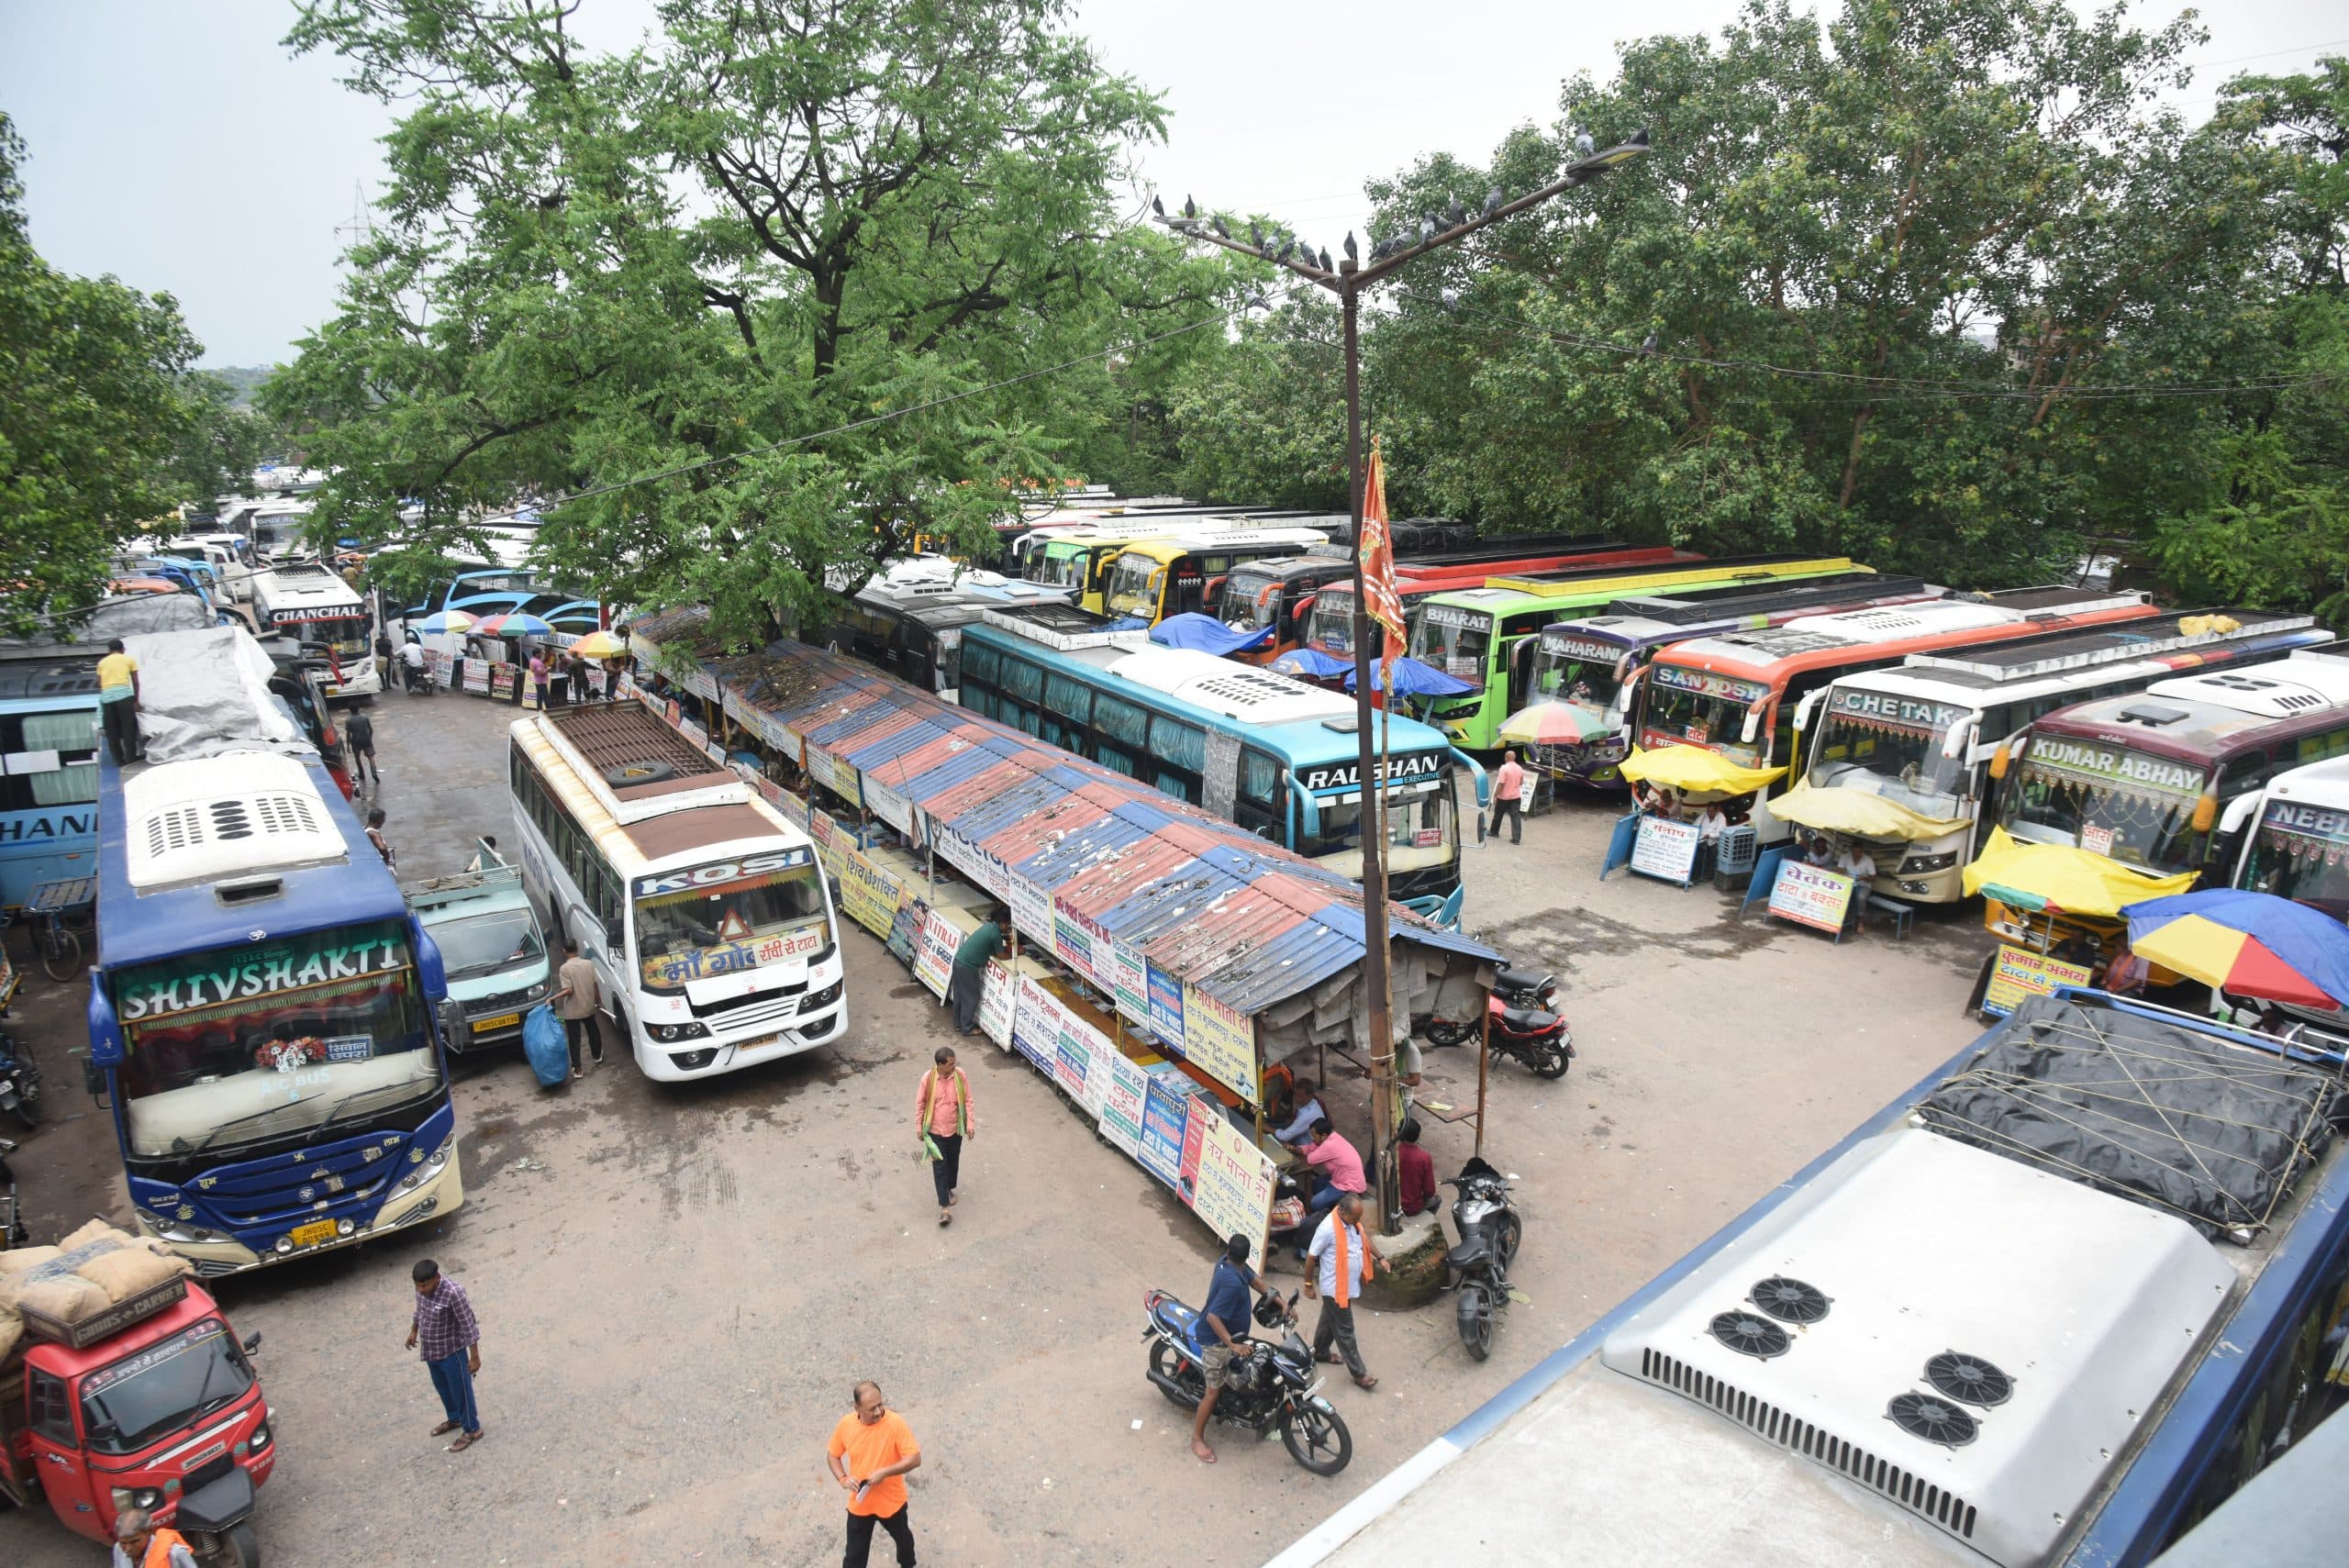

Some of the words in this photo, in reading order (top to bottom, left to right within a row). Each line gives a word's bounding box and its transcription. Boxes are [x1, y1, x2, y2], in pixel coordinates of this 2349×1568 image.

[273, 606, 360, 623] CHANCHAL
[1427, 607, 1490, 629] BHARAT
[1544, 637, 1622, 662] MAHARANI
[1659, 668, 1764, 701] SANTOSH
[1844, 693, 1955, 726] CHETAK
[1688, 728, 1707, 743] टाटा
[1404, 771, 1440, 784] EXECUTIVE
[2032, 738, 2115, 773] KUMAR
[2119, 758, 2201, 790] ABHAY
[642, 851, 809, 894] KOSI
[847, 852, 865, 881] शिव
[1786, 865, 1842, 891] चेतक
[1777, 882, 1799, 895] टाटा
[1810, 892, 1842, 909] बक्सर
[759, 939, 784, 962] राँची
[785, 937, 796, 955] से
[796, 934, 819, 952] टाटा
[1131, 950, 1143, 964] रथ
[124, 939, 401, 1020] SHIVSHAKTI
[2000, 964, 2029, 980] टाटा
[2002, 951, 2044, 971] कुमार
[2047, 963, 2086, 984] अभय
[1116, 974, 1147, 999] पटना
[1197, 987, 1211, 1011] जय
[1214, 995, 1237, 1027] माता
[295, 1066, 331, 1087] BUS
[1132, 1073, 1144, 1090] रथ
[1108, 1094, 1141, 1125] पटना
[1149, 1084, 1186, 1117] पावापुरी
[1207, 1138, 1224, 1165] जय
[1227, 1154, 1252, 1191] माता
[1254, 1175, 1268, 1205] दी
[1197, 1193, 1214, 1218] टाटा
[1216, 1209, 1224, 1228] से
[134, 1284, 184, 1315] CARRIER
